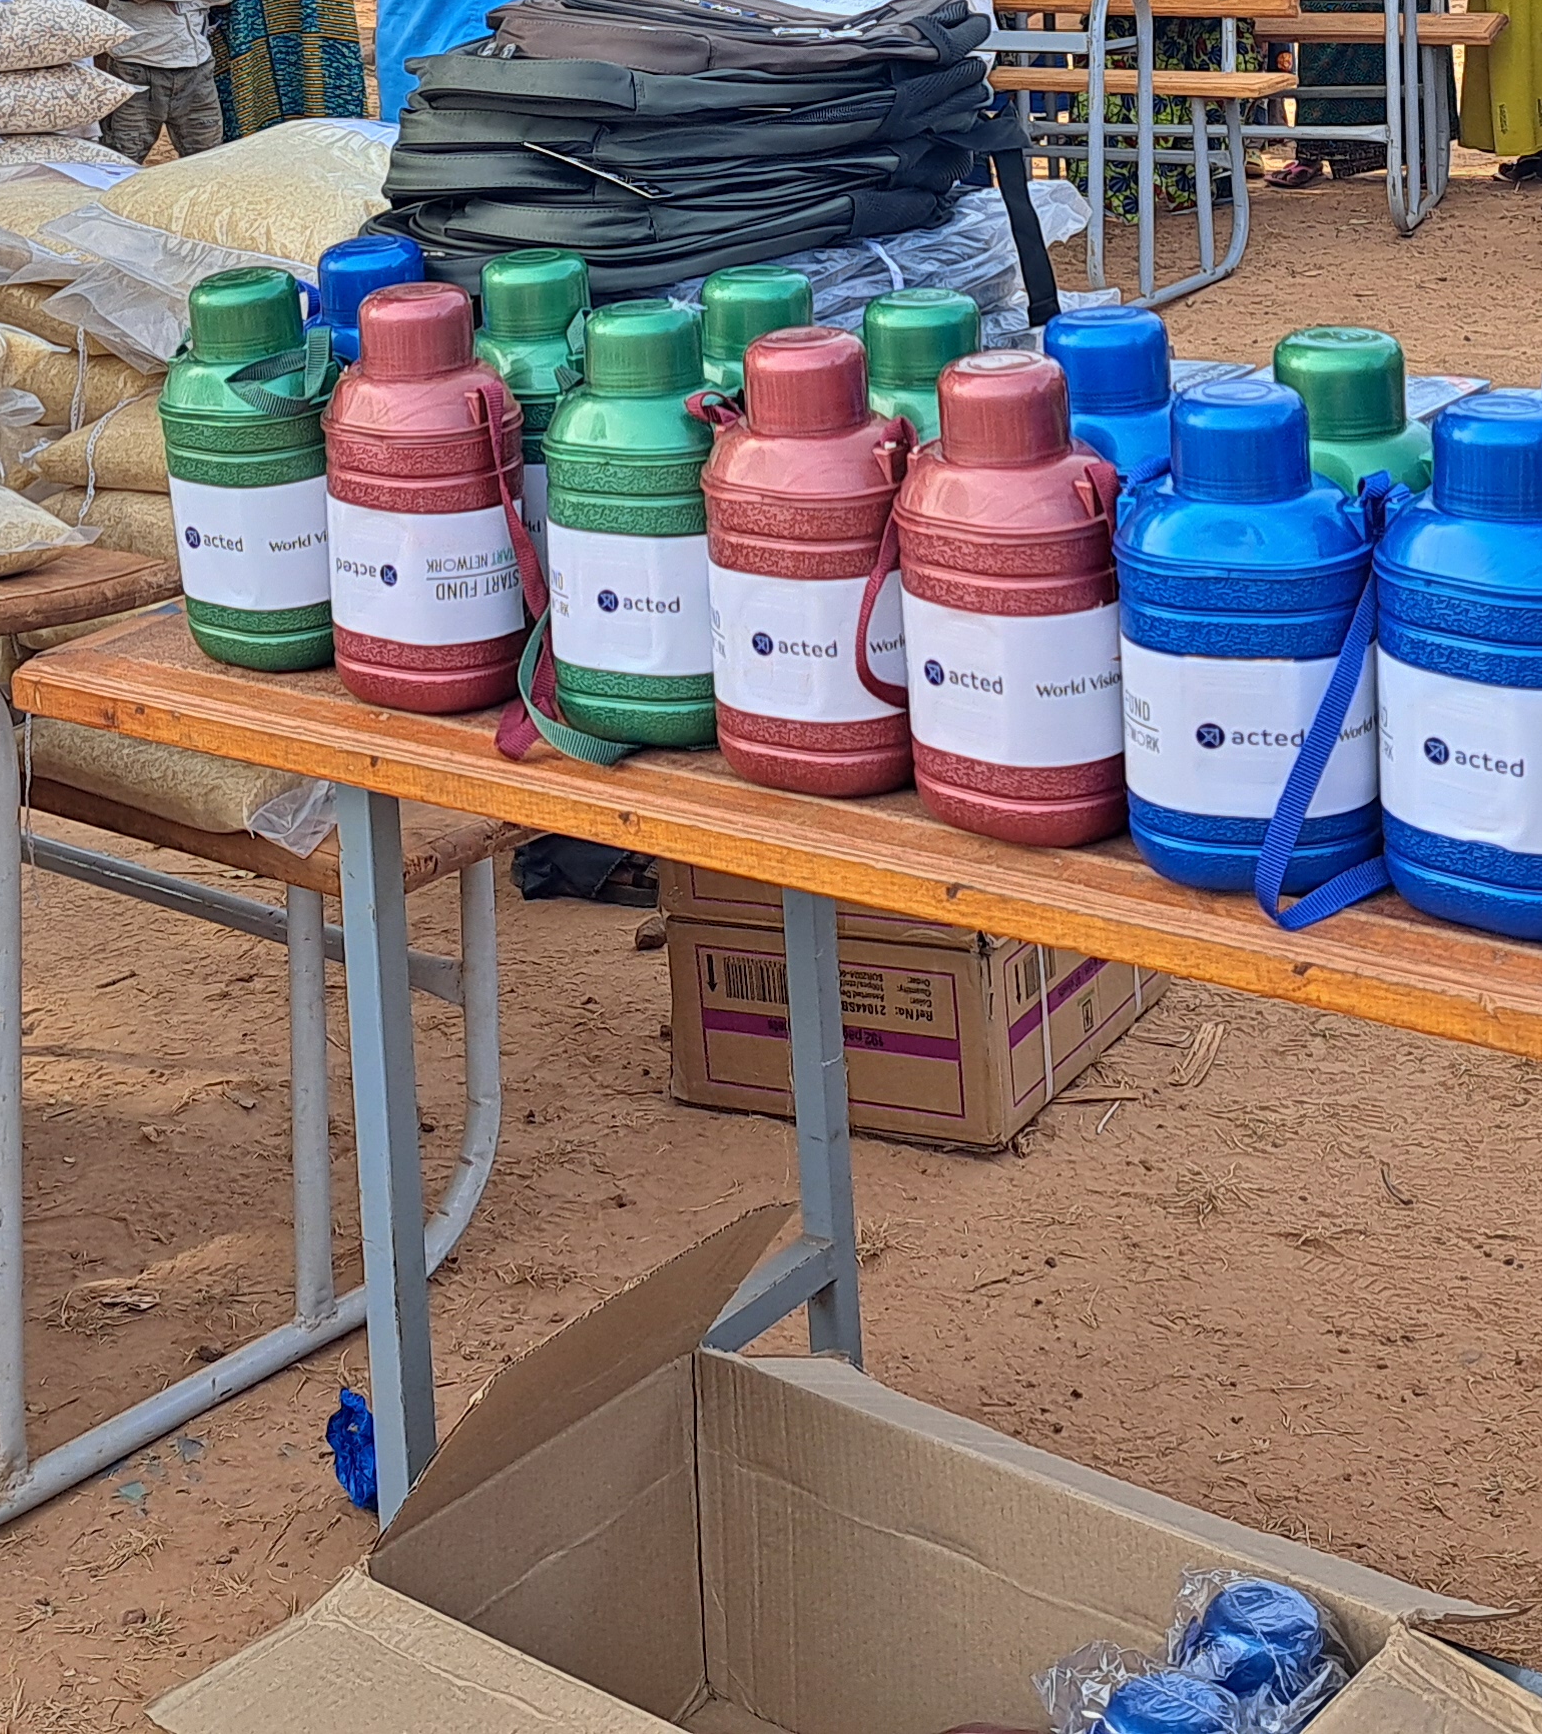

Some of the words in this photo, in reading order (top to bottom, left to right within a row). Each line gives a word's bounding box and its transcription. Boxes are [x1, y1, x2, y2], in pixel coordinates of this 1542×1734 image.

[203, 533, 244, 553] acted
[268, 534, 312, 553] World
[336, 557, 377, 578] acted
[426, 554, 488, 574] NETWORK
[435, 581, 479, 602] FUND
[483, 569, 520, 597] START
[623, 596, 681, 615] acted
[778, 639, 838, 658] acted
[949, 669, 1004, 696] acted
[1035, 677, 1086, 699] World
[1232, 728, 1304, 748] acted
[1338, 716, 1373, 743] World
[1455, 749, 1525, 778] acted
